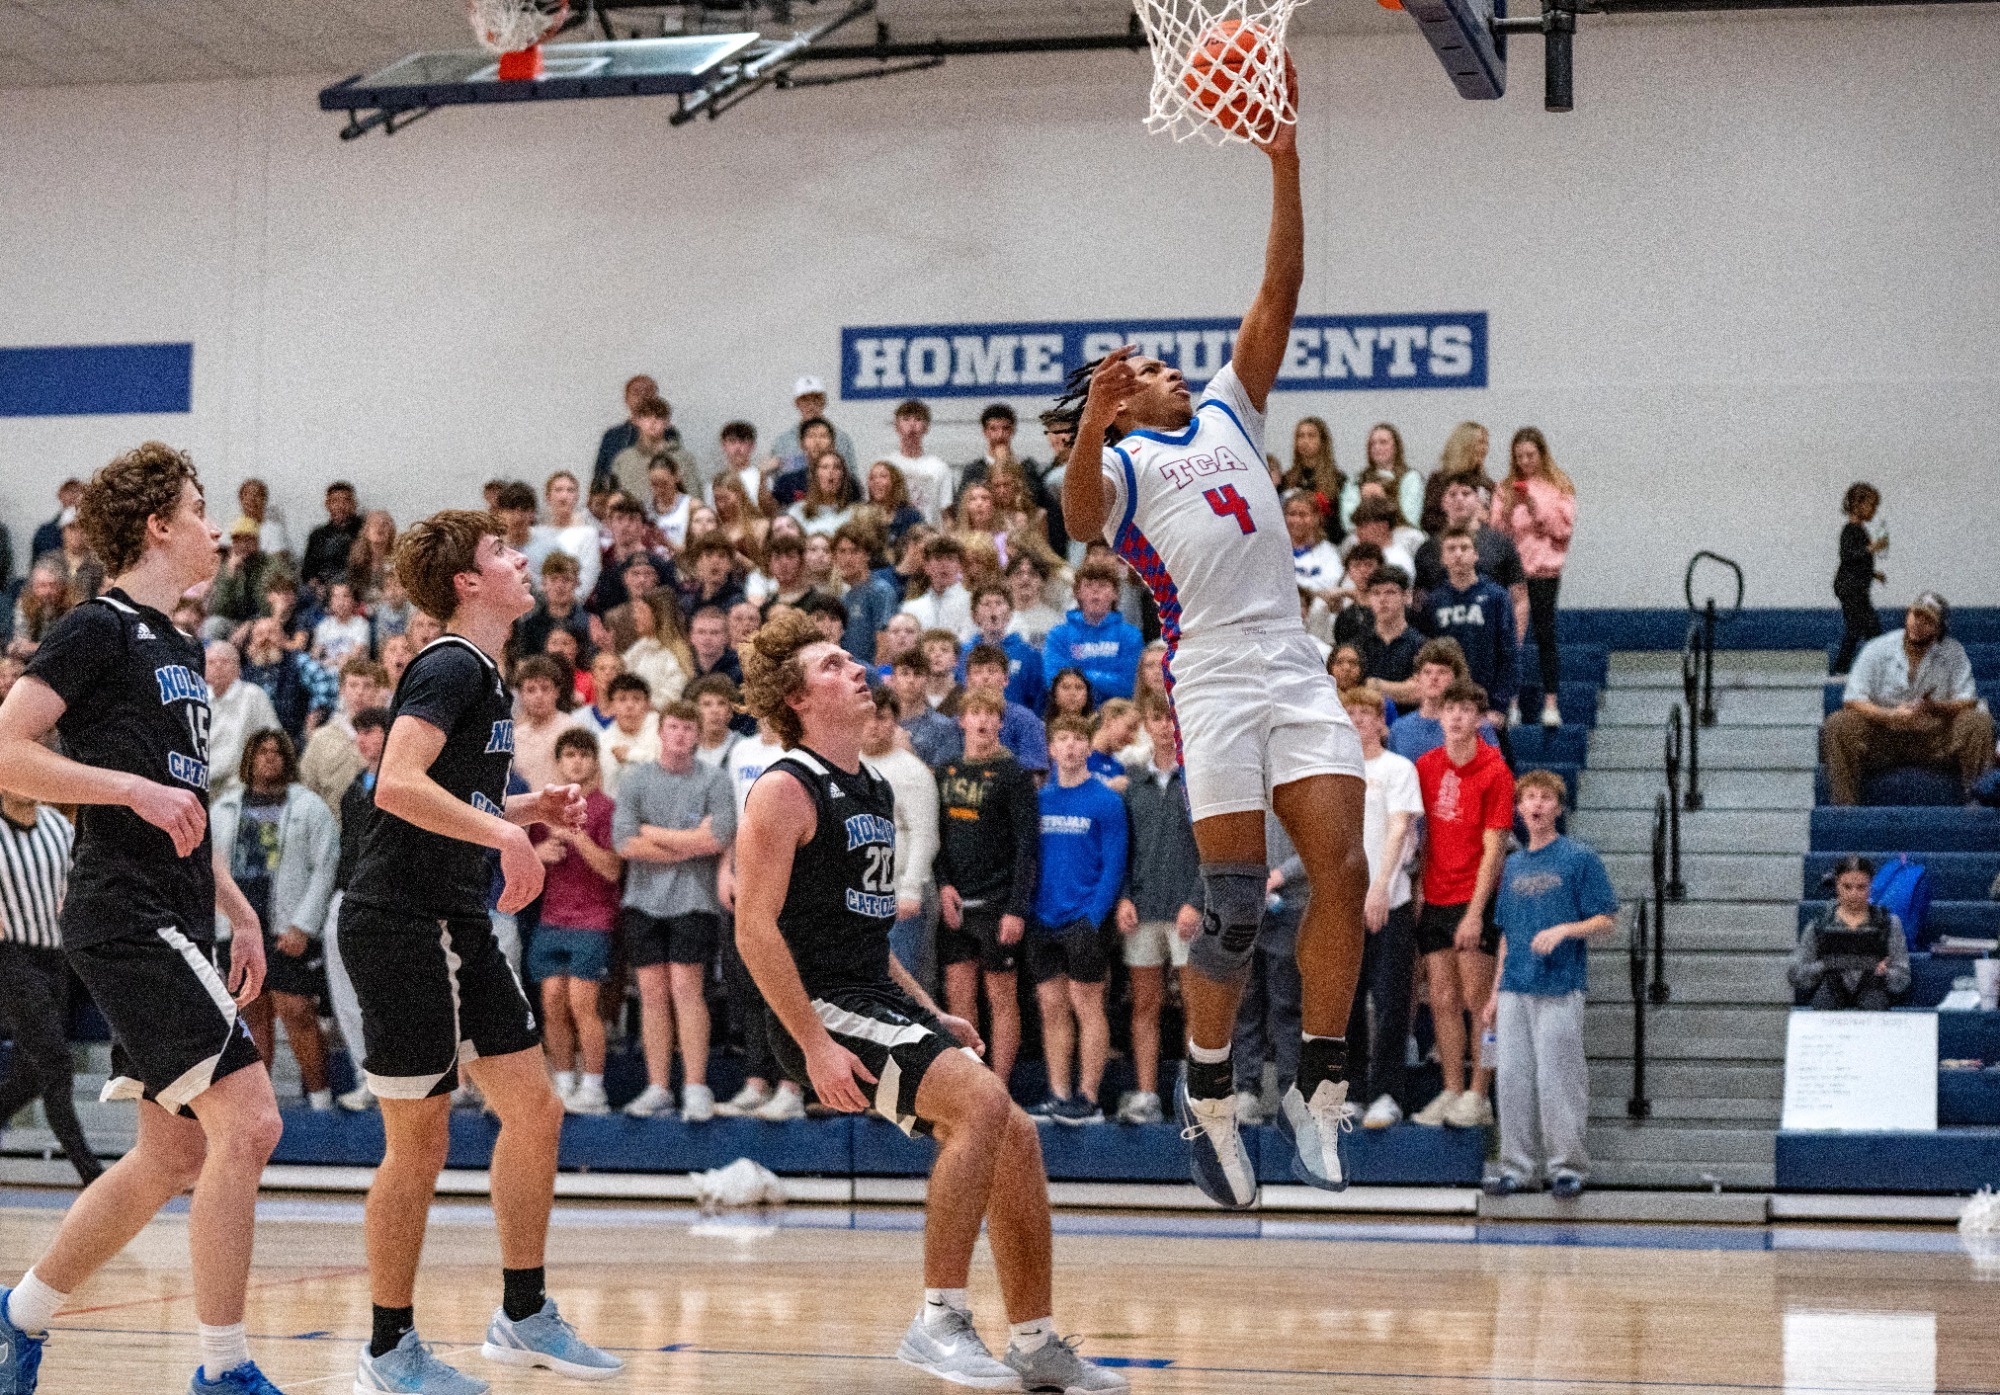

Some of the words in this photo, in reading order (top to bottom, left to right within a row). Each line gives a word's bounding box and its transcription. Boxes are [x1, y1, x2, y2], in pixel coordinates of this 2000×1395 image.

[854, 333, 1064, 388] HOME
[1082, 324, 1473, 380] STUENTS
[1160, 446, 1248, 489] TCA
[1202, 483, 1258, 535] 4
[1436, 604, 1485, 627] TCA
[186, 702, 209, 763] 15
